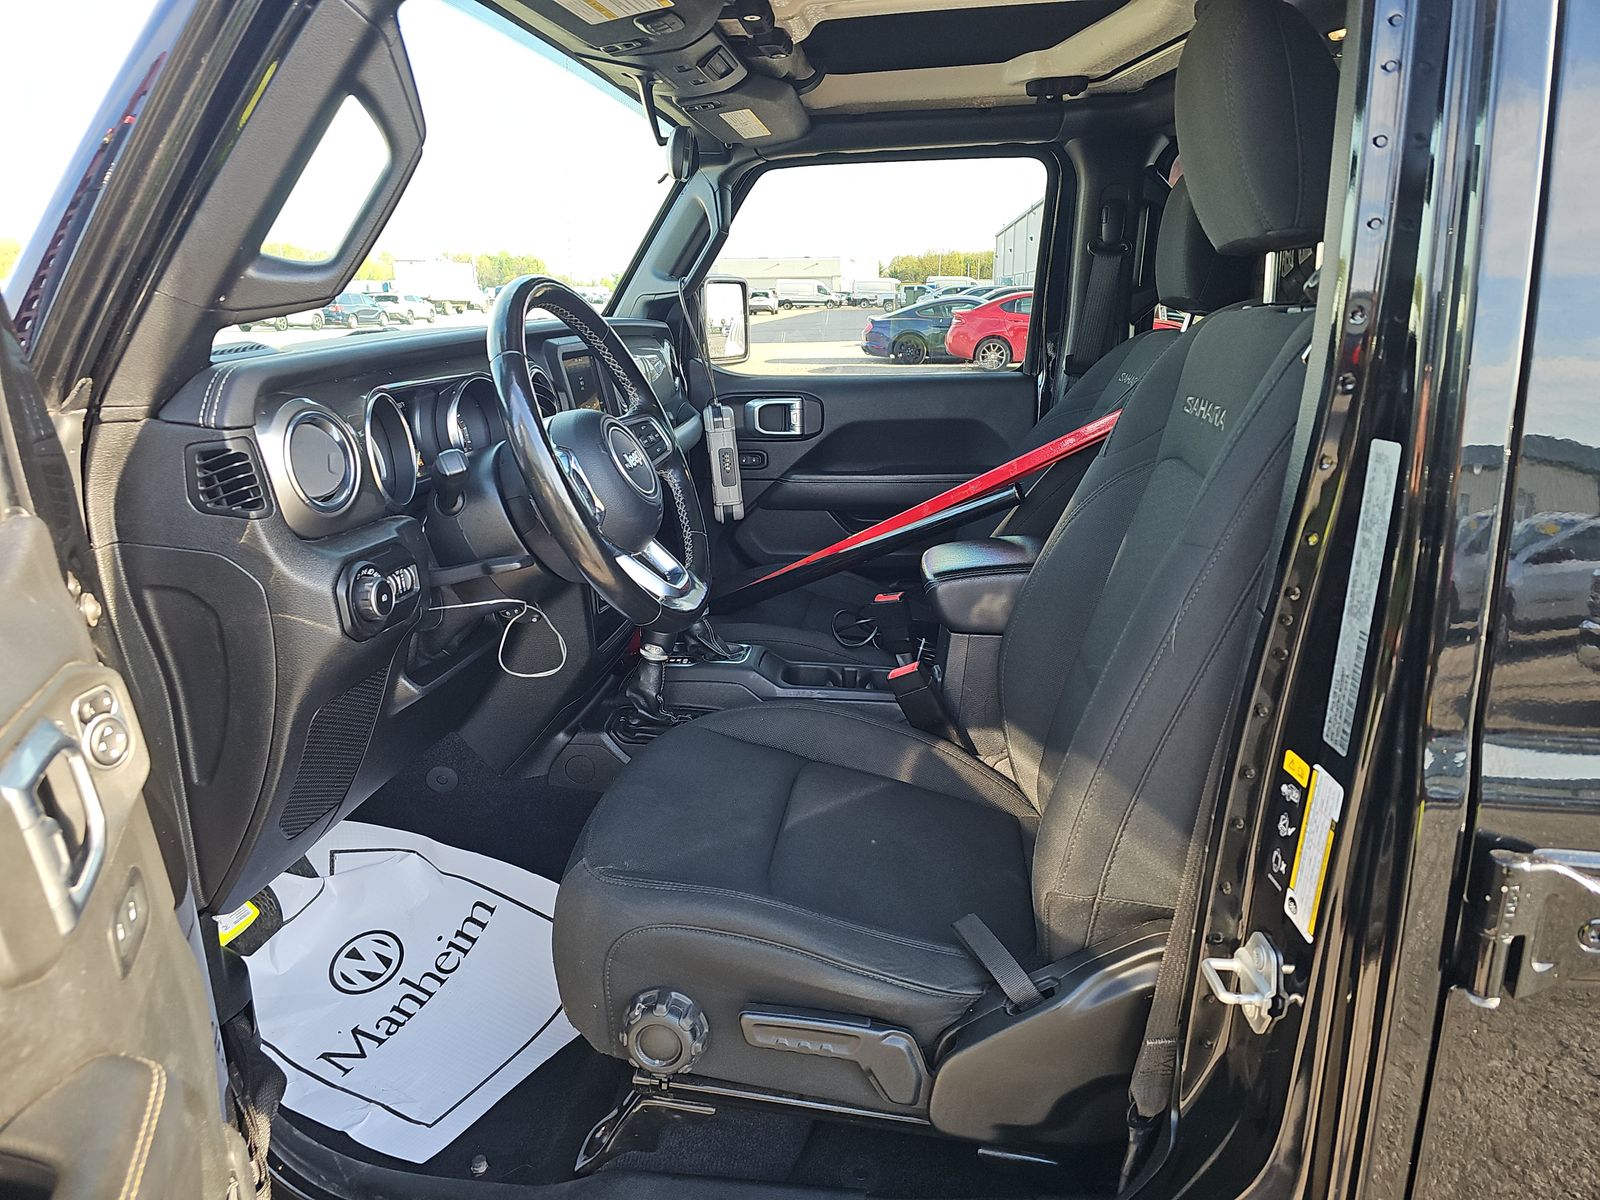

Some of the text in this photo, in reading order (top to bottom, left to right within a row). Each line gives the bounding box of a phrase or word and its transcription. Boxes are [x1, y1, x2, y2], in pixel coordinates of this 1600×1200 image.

[1183, 396, 1227, 431] SAHARA
[622, 450, 643, 469] Jeep
[316, 899, 497, 1077] Manheim
